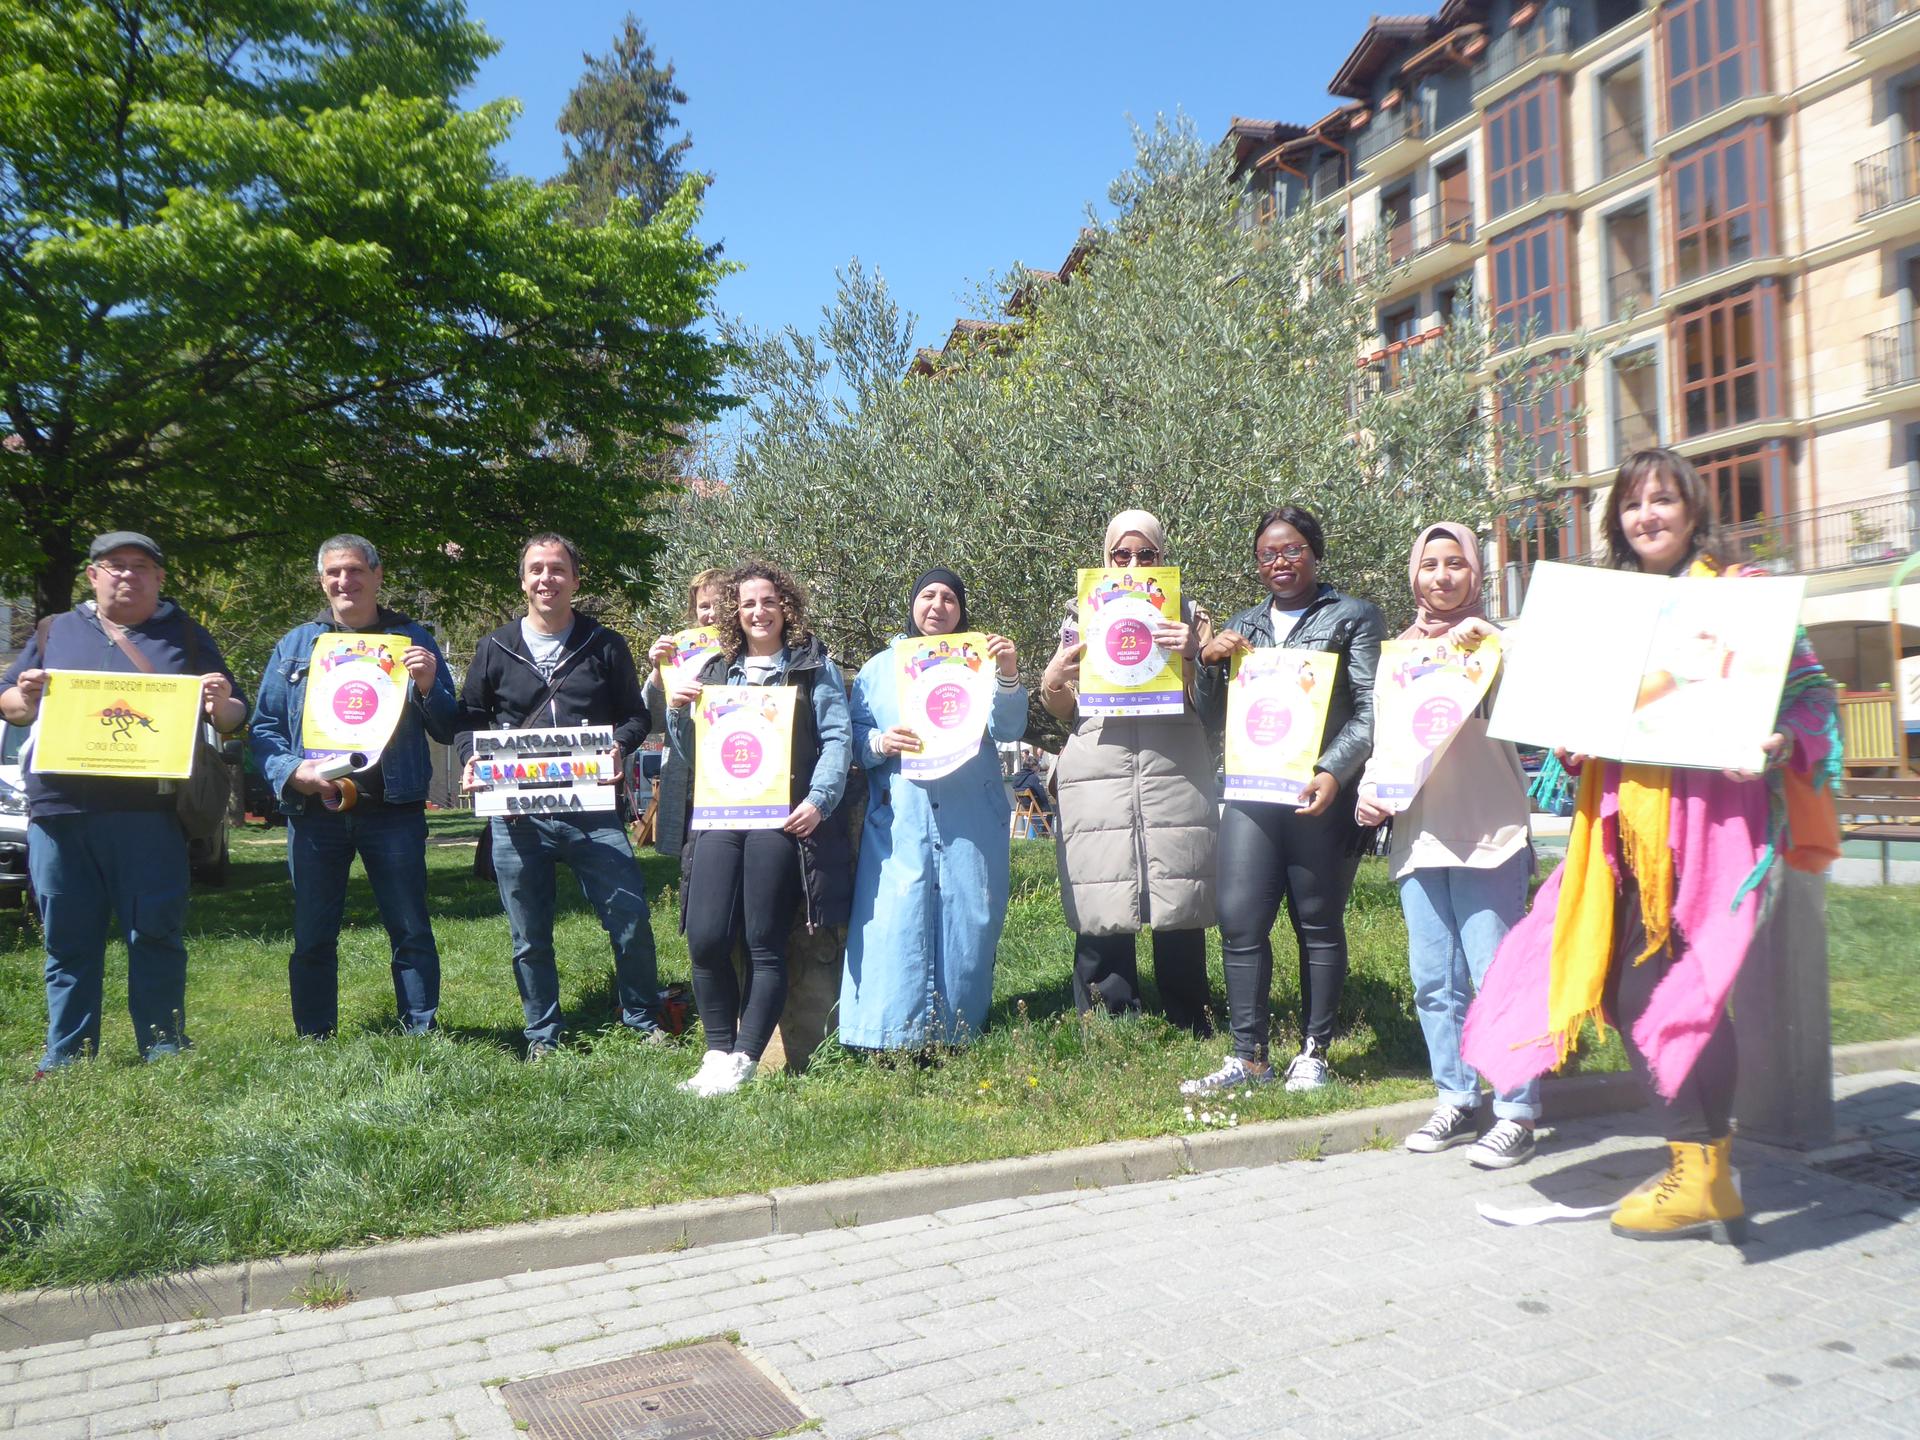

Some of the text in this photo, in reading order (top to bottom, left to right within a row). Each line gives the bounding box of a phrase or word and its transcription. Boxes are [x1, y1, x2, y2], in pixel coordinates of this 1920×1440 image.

[1120, 635, 1137, 649] 23
[347, 696, 363, 709] 23
[943, 700, 957, 714] 23
[1259, 715, 1275, 729] 23
[1431, 716, 1448, 731] 23
[735, 748, 749, 762] 23
[480, 761, 598, 781] ELKARTASUN
[506, 793, 582, 810] ESKOLA
